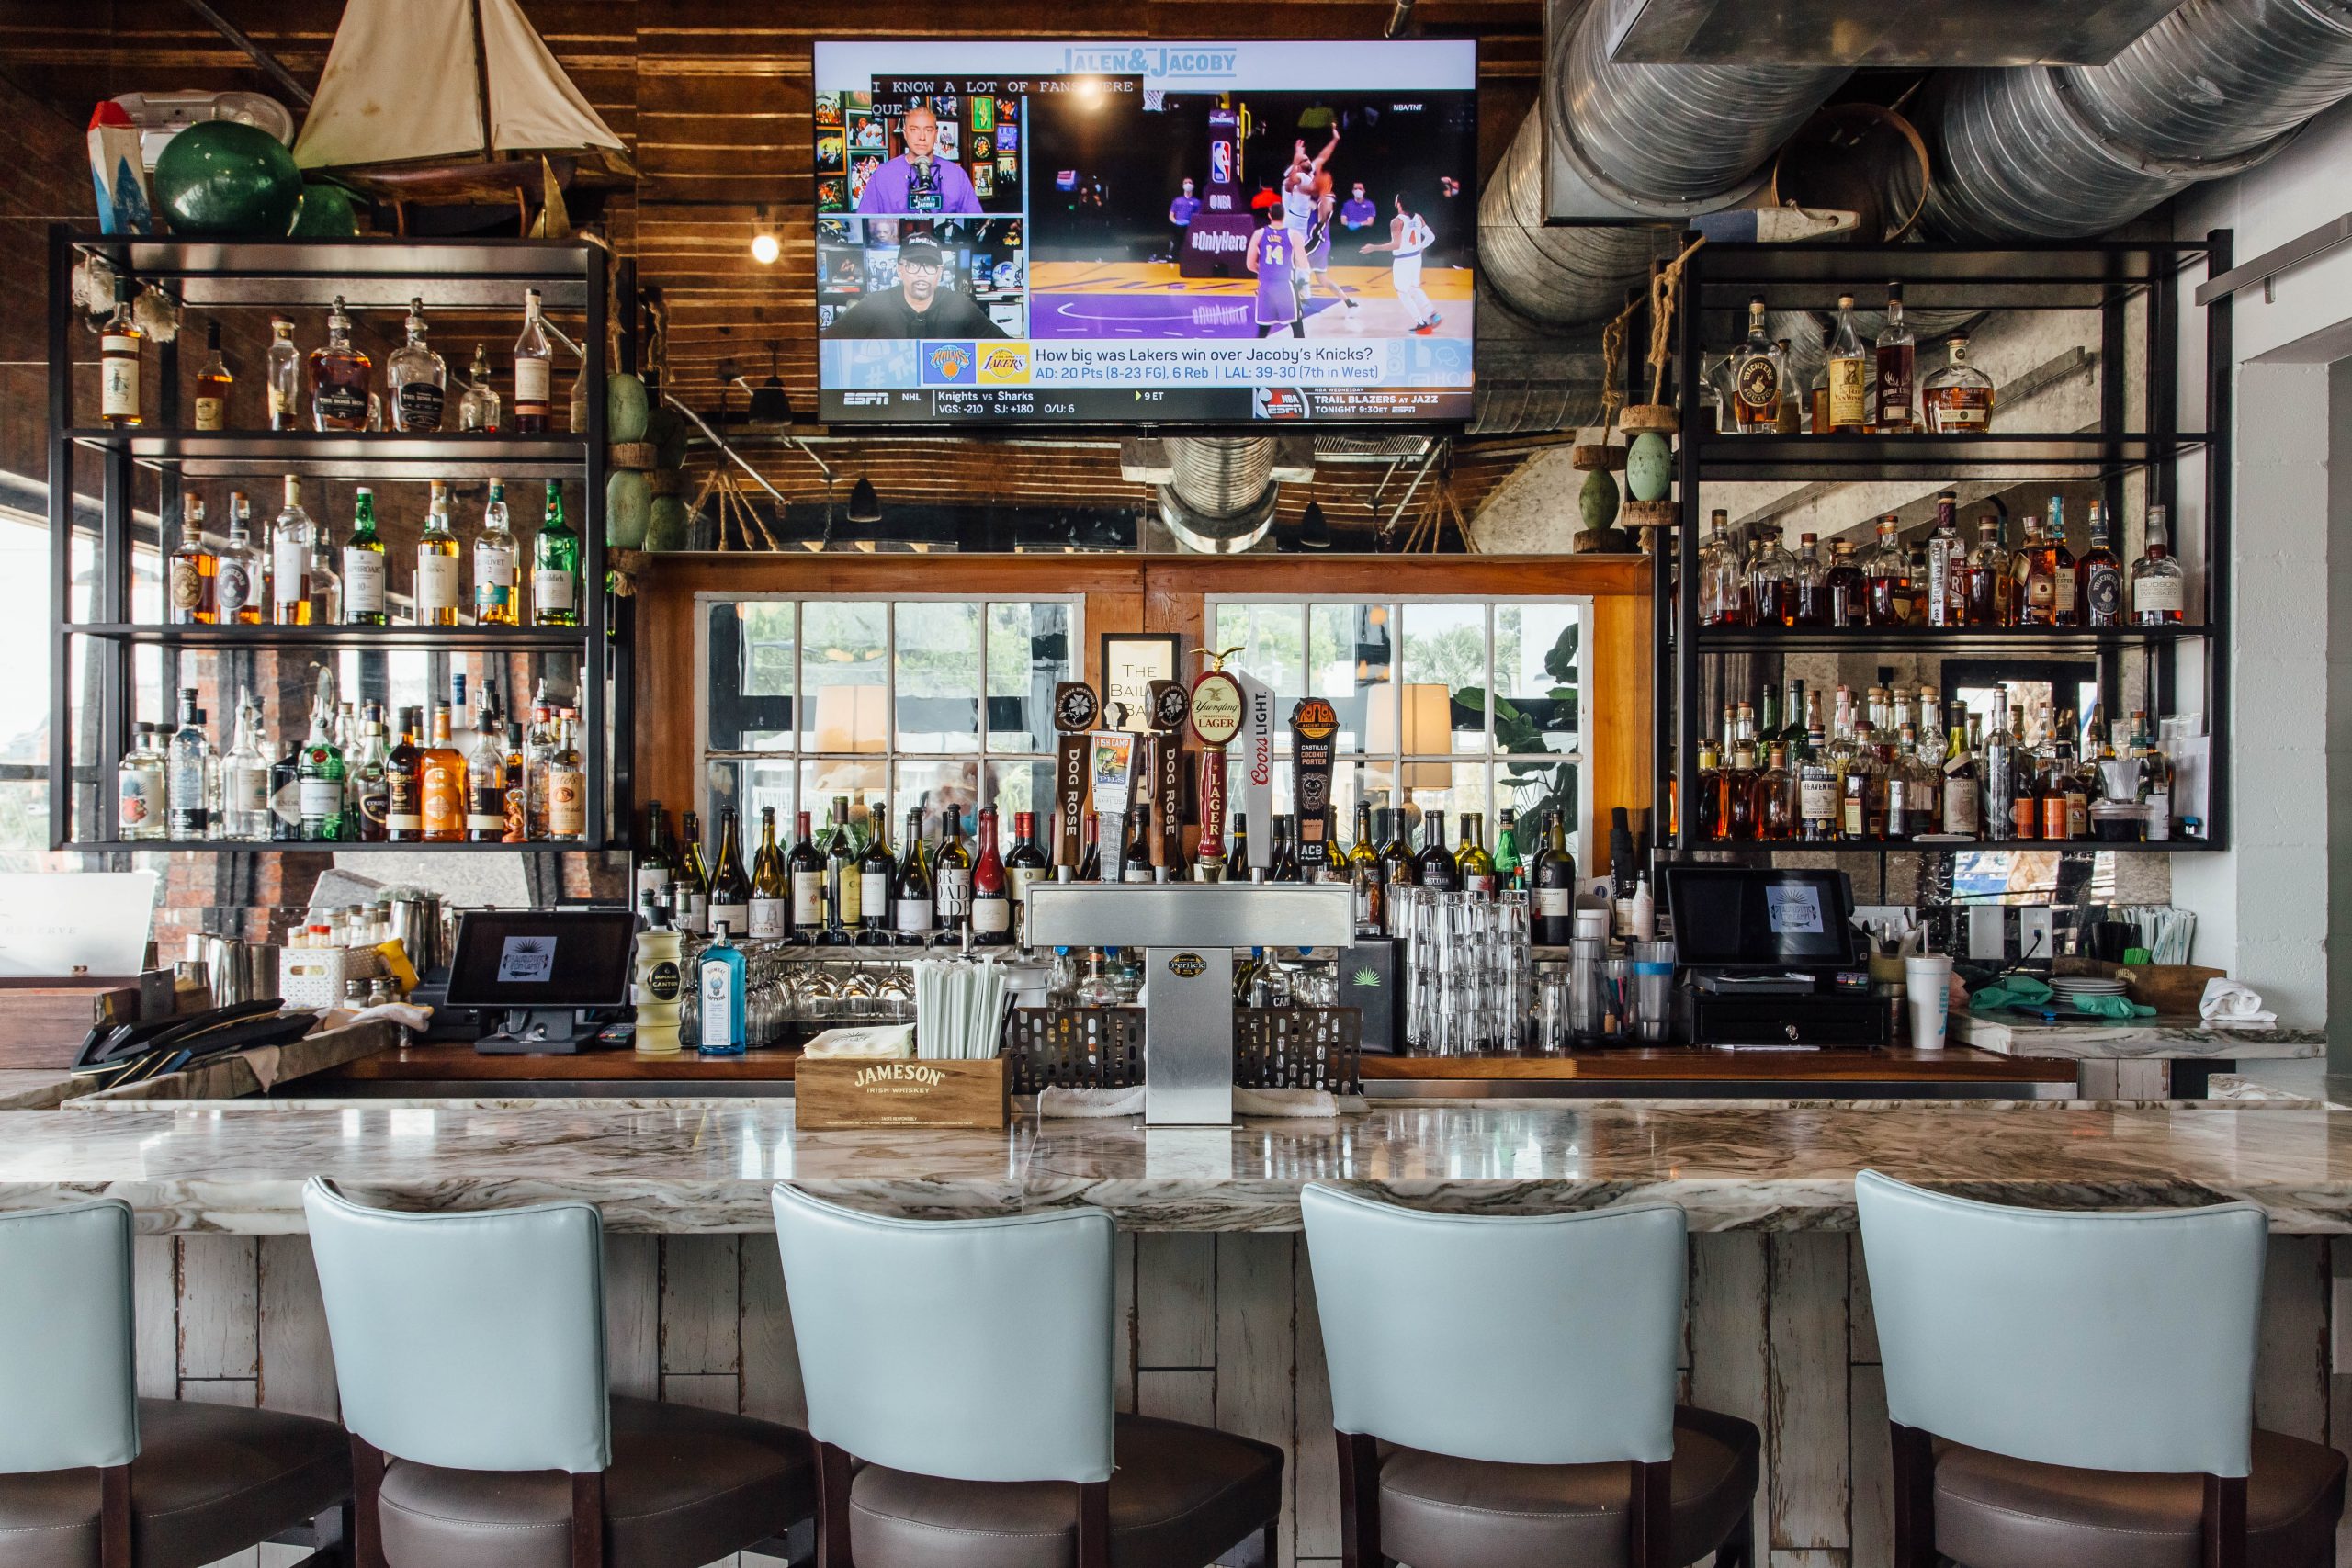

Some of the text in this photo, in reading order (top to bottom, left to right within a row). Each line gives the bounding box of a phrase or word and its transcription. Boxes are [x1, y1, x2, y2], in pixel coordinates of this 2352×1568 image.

[872, 81, 880, 92] I
[893, 81, 934, 93] KNOW
[944, 81, 956, 92] A
[966, 81, 997, 93] LOT
[1007, 81, 1028, 93] OF
[1091, 81, 1133, 93] ERE
[1192, 231, 1248, 254] #OnlyHere
[1265, 244, 1284, 265] 14
[1035, 348, 1373, 366] How big was Lakers win over Jacoby's Knicks?
[1035, 367, 1379, 380] AD: 20 Pts (8-23 FG), 6 Reb LAL: 39-30 (7th in West)
[843, 392, 889, 405] ESPN
[902, 392, 921, 401] NHL
[937, 390, 1034, 403] Knights vs Sharks
[1144, 392, 1164, 400] 9 ET
[1282, 394, 1299, 404] NBA
[1314, 395, 1345, 404] TRAIL
[1349, 395, 1396, 404] BLAZERS
[1411, 395, 1439, 404] JAZZ
[938, 404, 1075, 414] VGS: -210 SJ: +180 O/U: 6
[1267, 404, 1303, 413] ESPN
[1122, 664, 1158, 678] THE
[1110, 683, 1146, 697] BAIL
[1193, 700, 1238, 713] Yuengling
[1198, 718, 1235, 728] LAGER
[1096, 737, 1129, 748] FISH CAMP
[1250, 693, 1269, 786] Coors LIGHT
[1098, 775, 1125, 784] PILS
[1066, 748, 1080, 836] DOG ROSE
[1165, 748, 1176, 836] DOG ROSE
[1209, 773, 1221, 836] LAGER
[1301, 844, 1323, 855] ACB
[1171, 961, 1205, 969] Perlick
[854, 1064, 942, 1087] JAMESON
